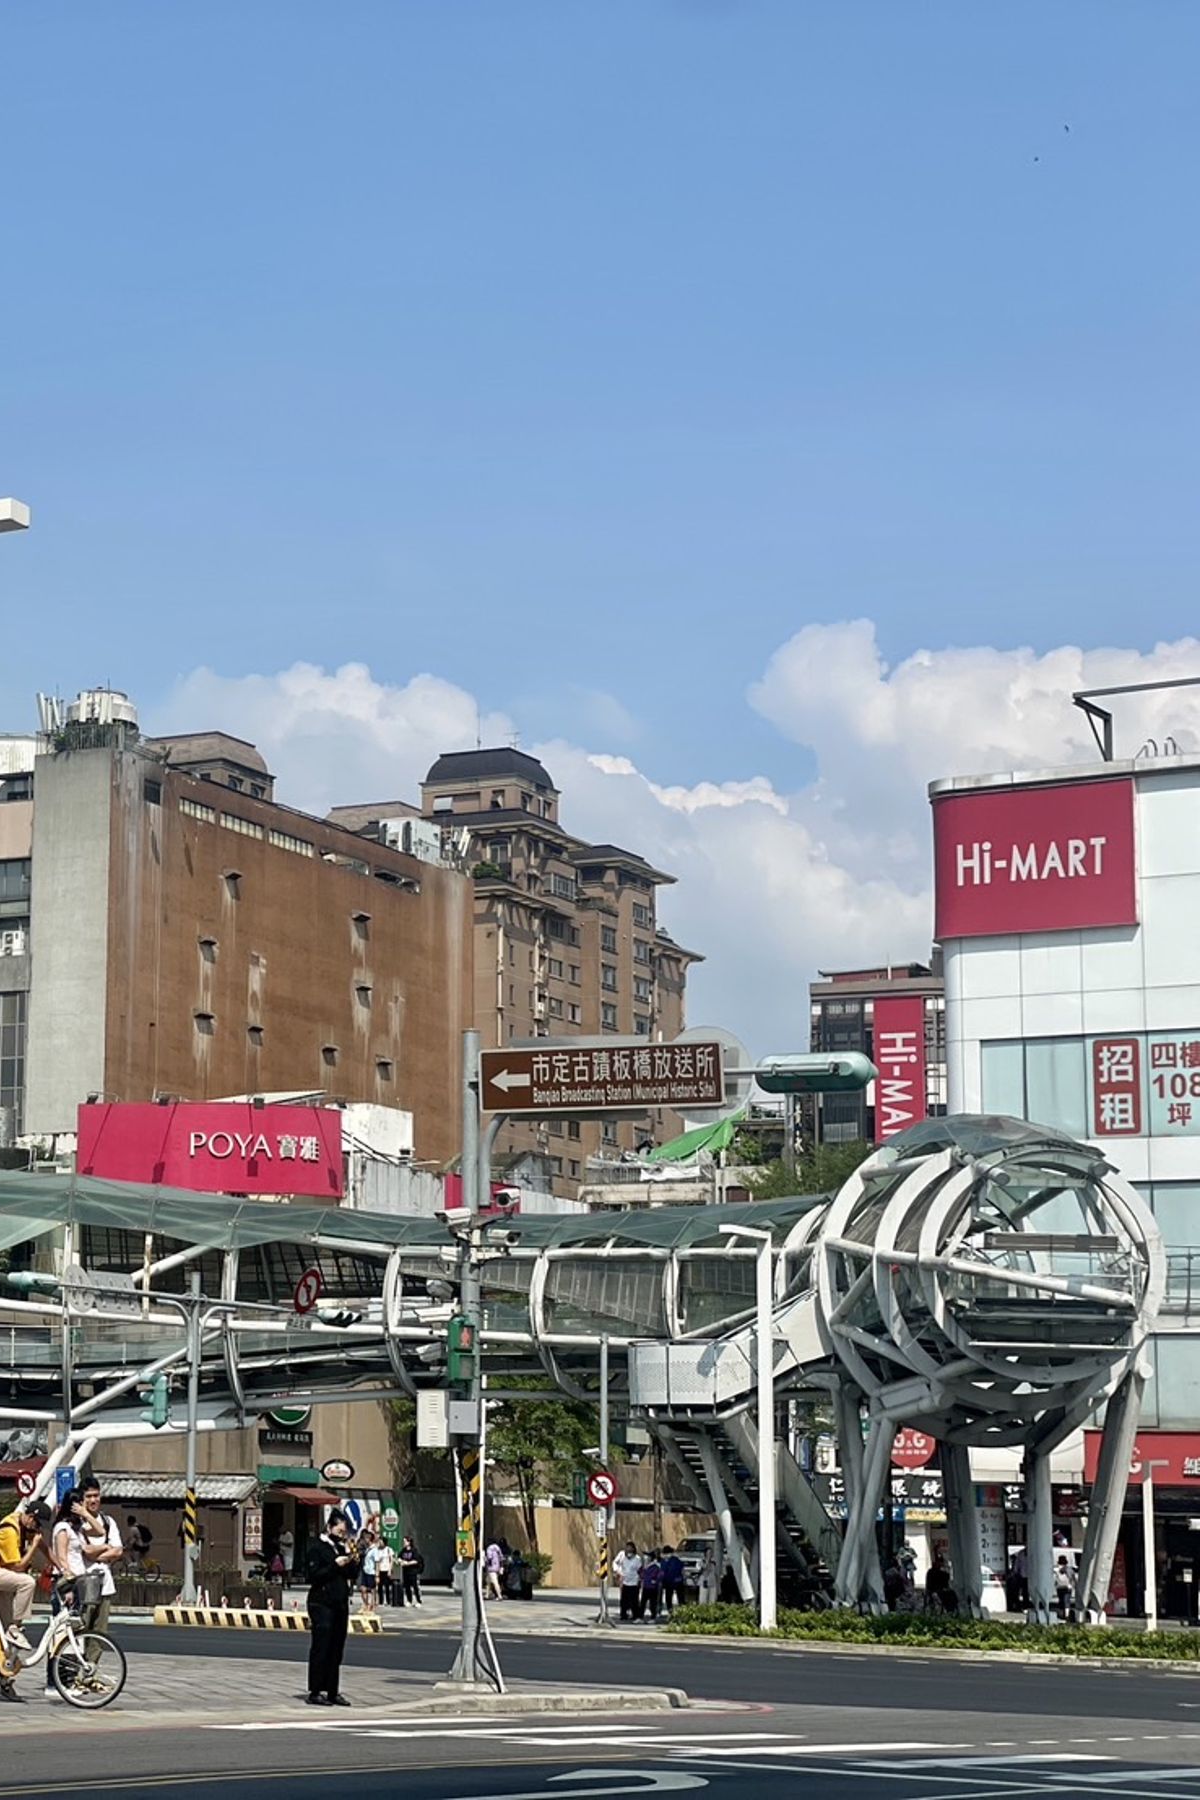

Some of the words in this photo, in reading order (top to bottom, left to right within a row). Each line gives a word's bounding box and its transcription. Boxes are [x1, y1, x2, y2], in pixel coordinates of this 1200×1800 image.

[956, 836, 1107, 887] Hi-MART
[531, 1045, 715, 1084] 市定古蹟板橋放送所
[1150, 1040, 1200, 1070] 四樓
[532, 1086, 560, 1106] Banqiao
[560, 1084, 606, 1106] Broadcasting
[606, 1083, 632, 1101] Station
[632, 1081, 670, 1103] (Municipal
[670, 1080, 698, 1099] Historic
[698, 1079, 717, 1099] Site)
[1098, 1044, 1136, 1131] 招租
[1152, 1071, 1200, 1099] 108
[1167, 1102, 1193, 1127] 坪
[189, 1131, 273, 1160] POYA
